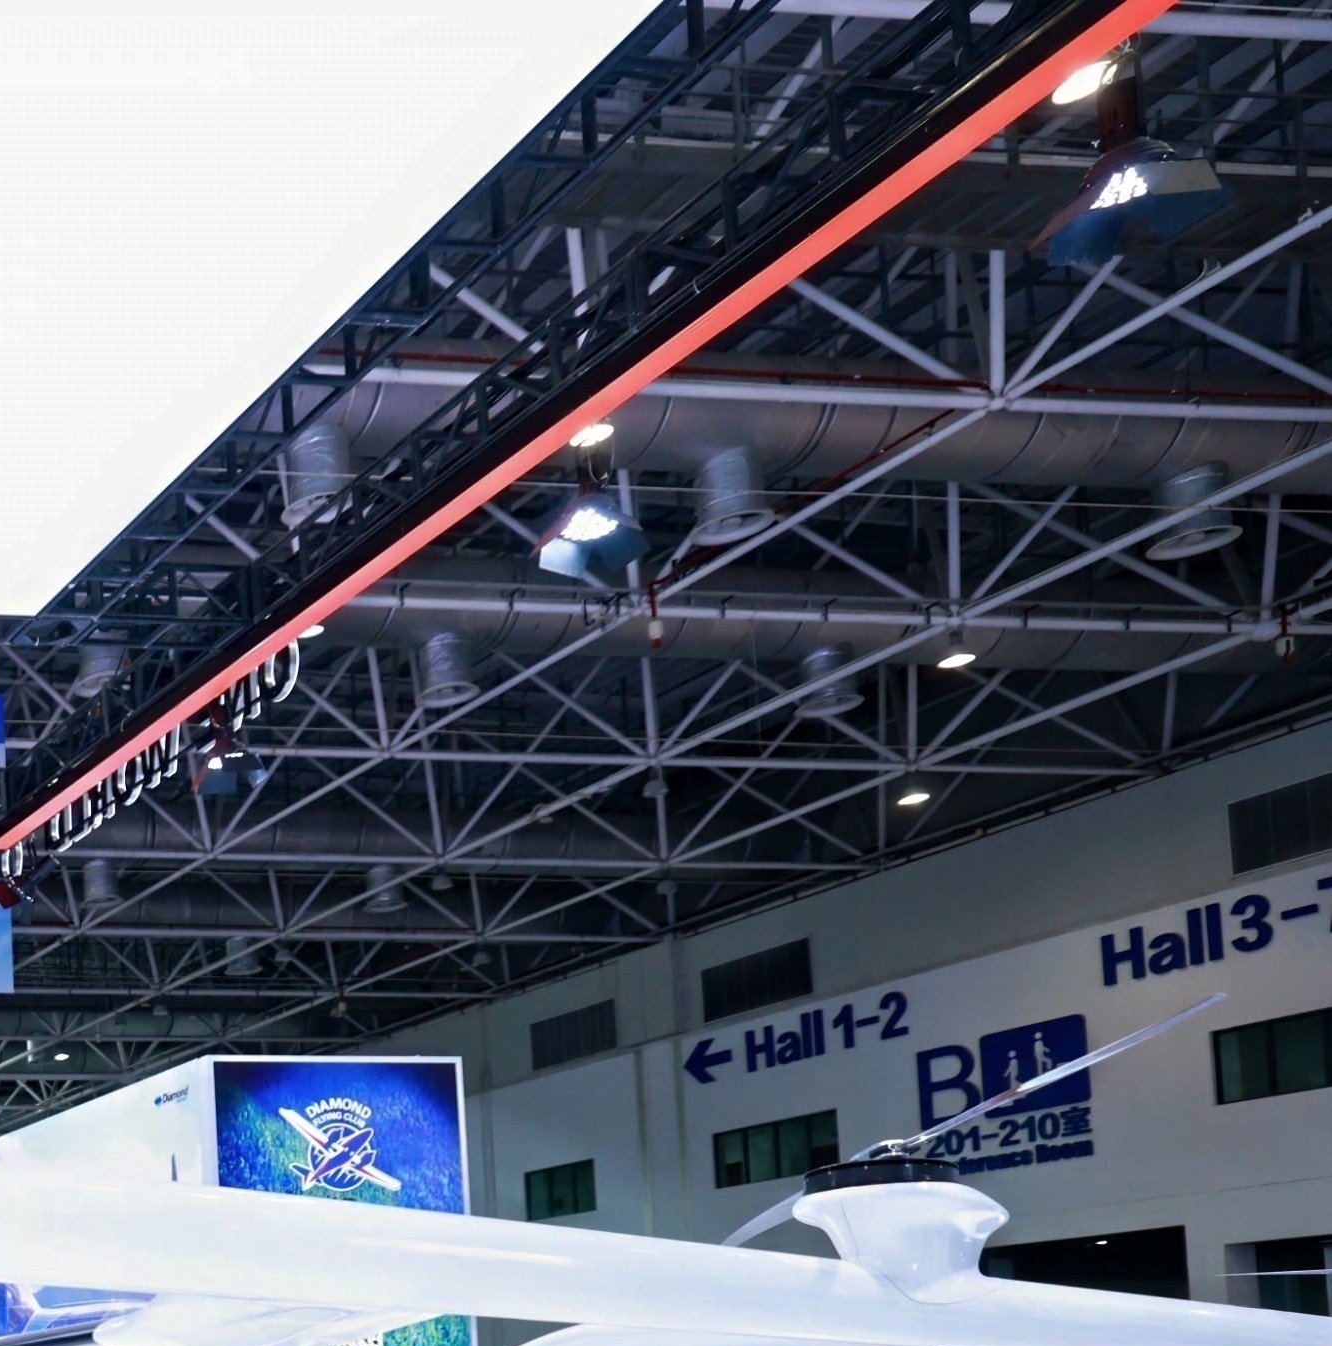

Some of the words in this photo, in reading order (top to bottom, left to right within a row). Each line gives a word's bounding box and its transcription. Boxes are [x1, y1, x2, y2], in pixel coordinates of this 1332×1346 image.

[1101, 902, 1224, 987] Hall
[745, 1008, 826, 1073] Hall
[833, 990, 910, 1049] 1-2
[305, 1097, 372, 1119] DIAMOND
[312, 1111, 342, 1127] FLYING
[343, 1113, 366, 1128] CLUB
[917, 1045, 981, 1131] B
